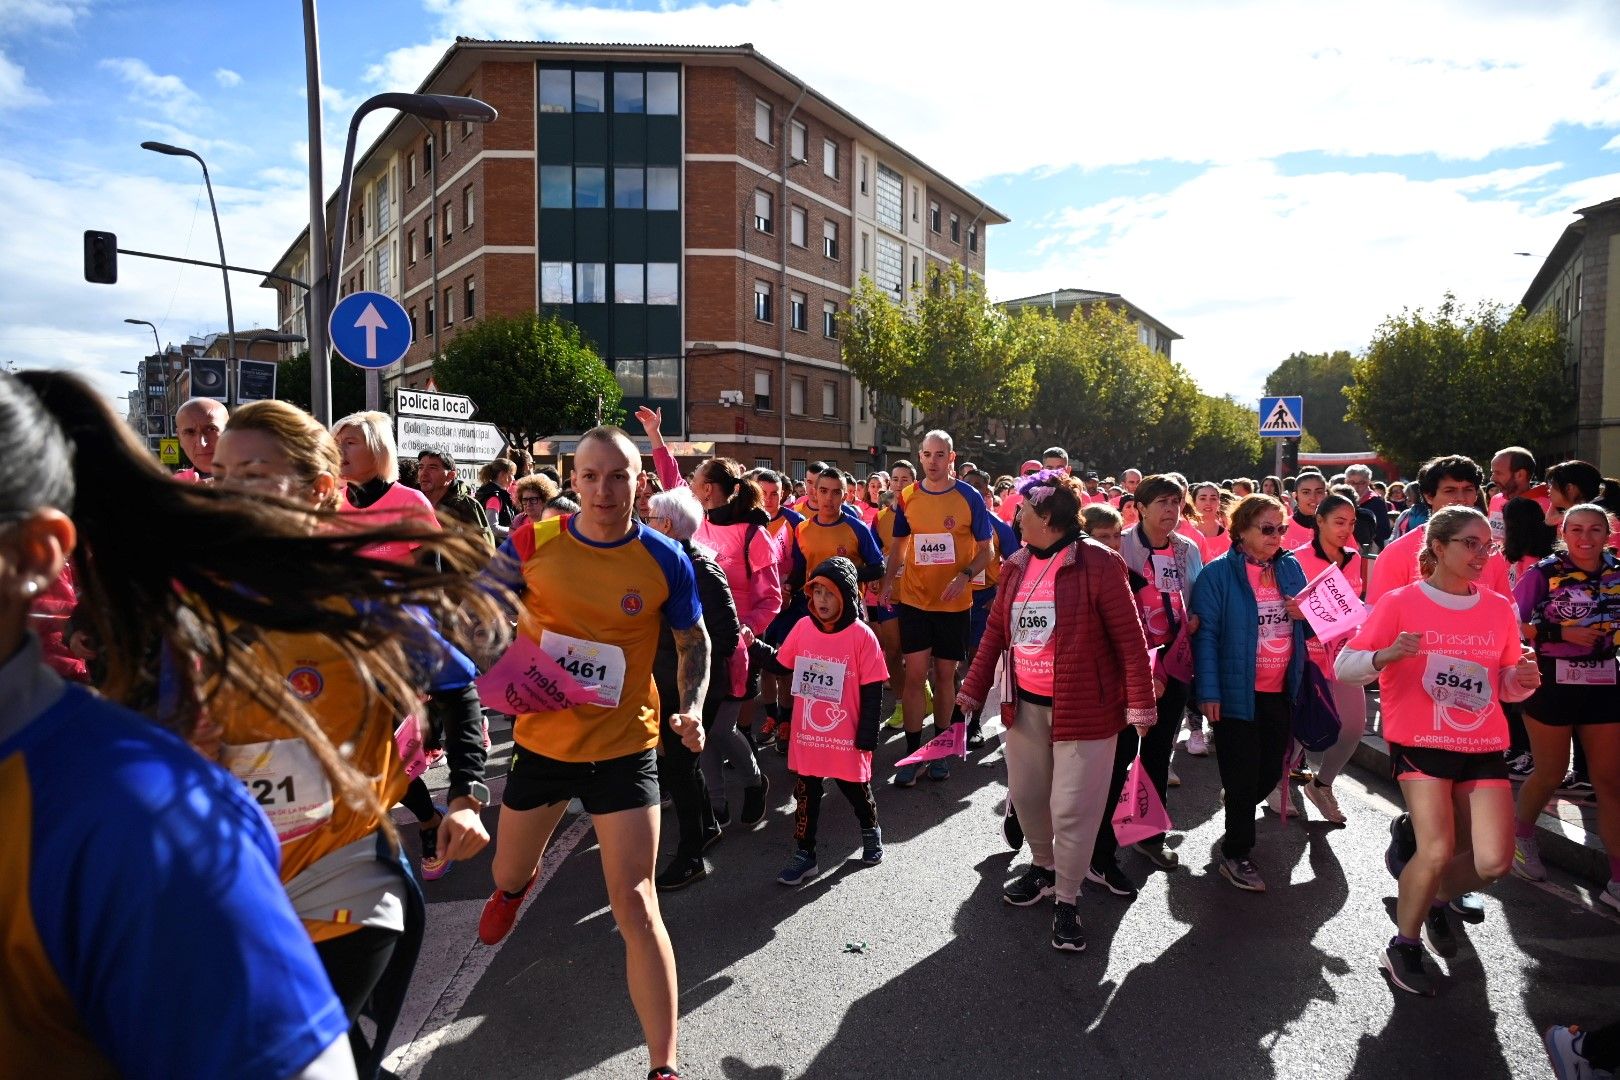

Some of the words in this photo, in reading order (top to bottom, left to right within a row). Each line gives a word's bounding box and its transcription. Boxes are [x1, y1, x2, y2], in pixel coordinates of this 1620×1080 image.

[443, 398, 469, 414] local
[920, 543, 946, 552] 4449
[1324, 577, 1352, 615] Ezedent
[1018, 616, 1048, 628] 0366
[802, 671, 834, 687] 5713
[1435, 672, 1483, 693] 5941
[1414, 735, 1455, 743] CARRERA
[243, 776, 296, 805] 21
